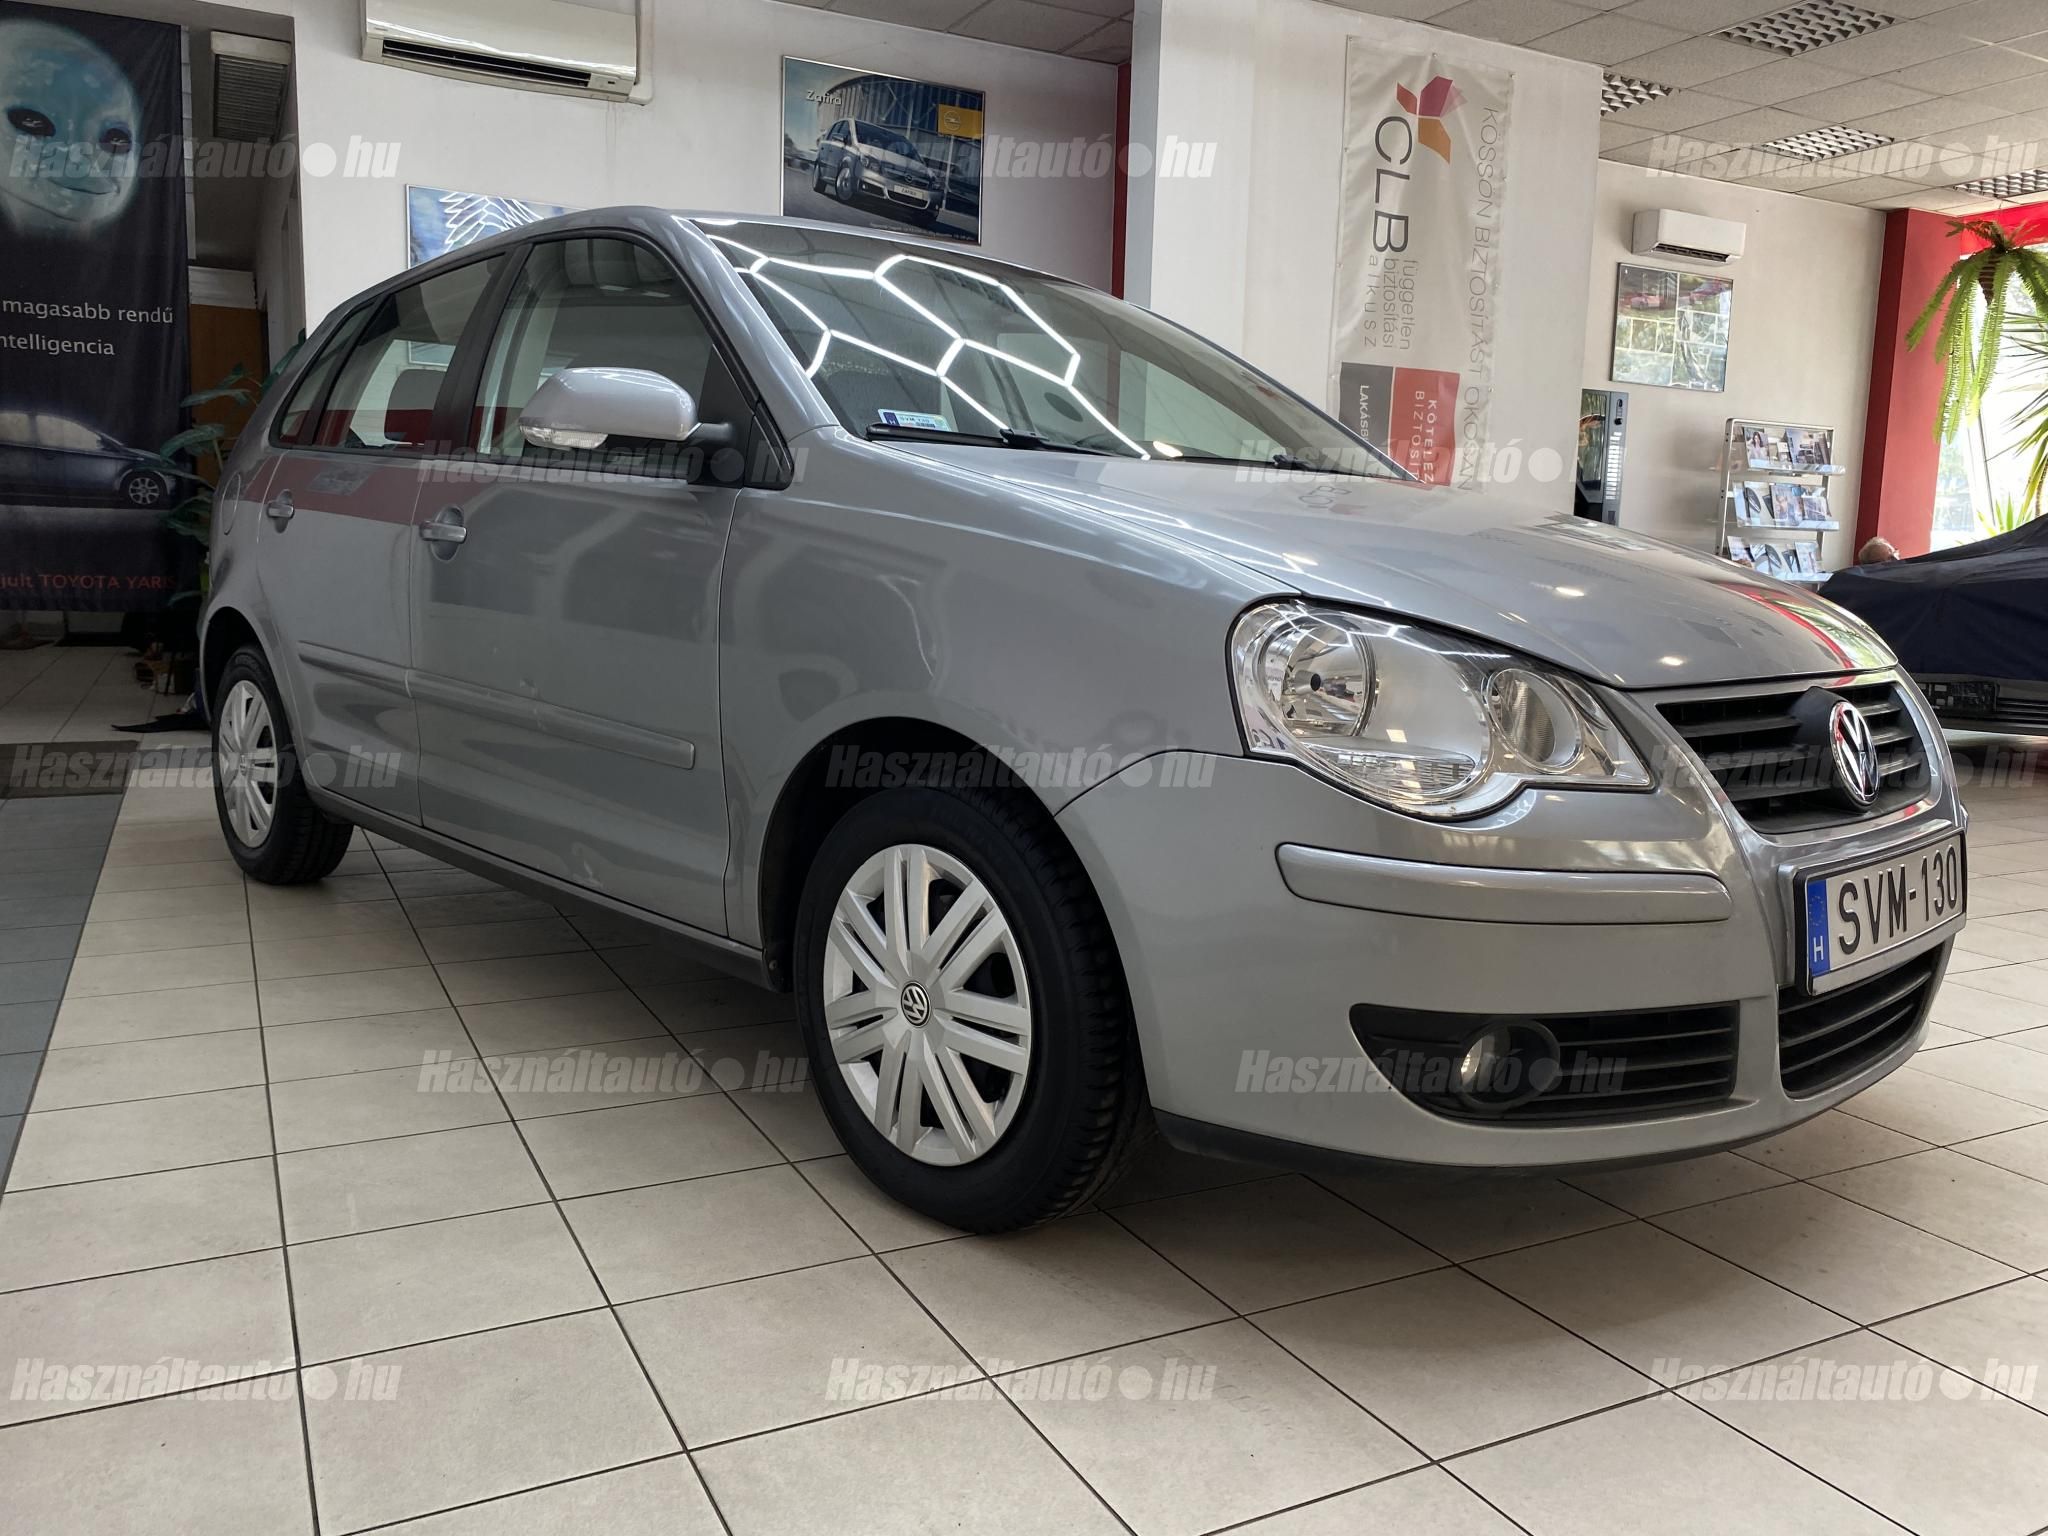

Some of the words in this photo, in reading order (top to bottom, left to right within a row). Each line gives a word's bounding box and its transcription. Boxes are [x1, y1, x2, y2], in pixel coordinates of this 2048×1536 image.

[1373, 116, 1413, 252] CLB
[3, 300, 111, 320] magasabb
[118, 307, 173, 323] rendű
[1383, 258, 1399, 348] biztosítási
[1399, 259, 1419, 350] független
[1457, 386, 1480, 491] OKOSAN
[38, 574, 120, 589] TOYOTA
[126, 576, 176, 590] YARIS
[1838, 844, 1958, 956] SVM-130
[1813, 935, 1824, 963] H
